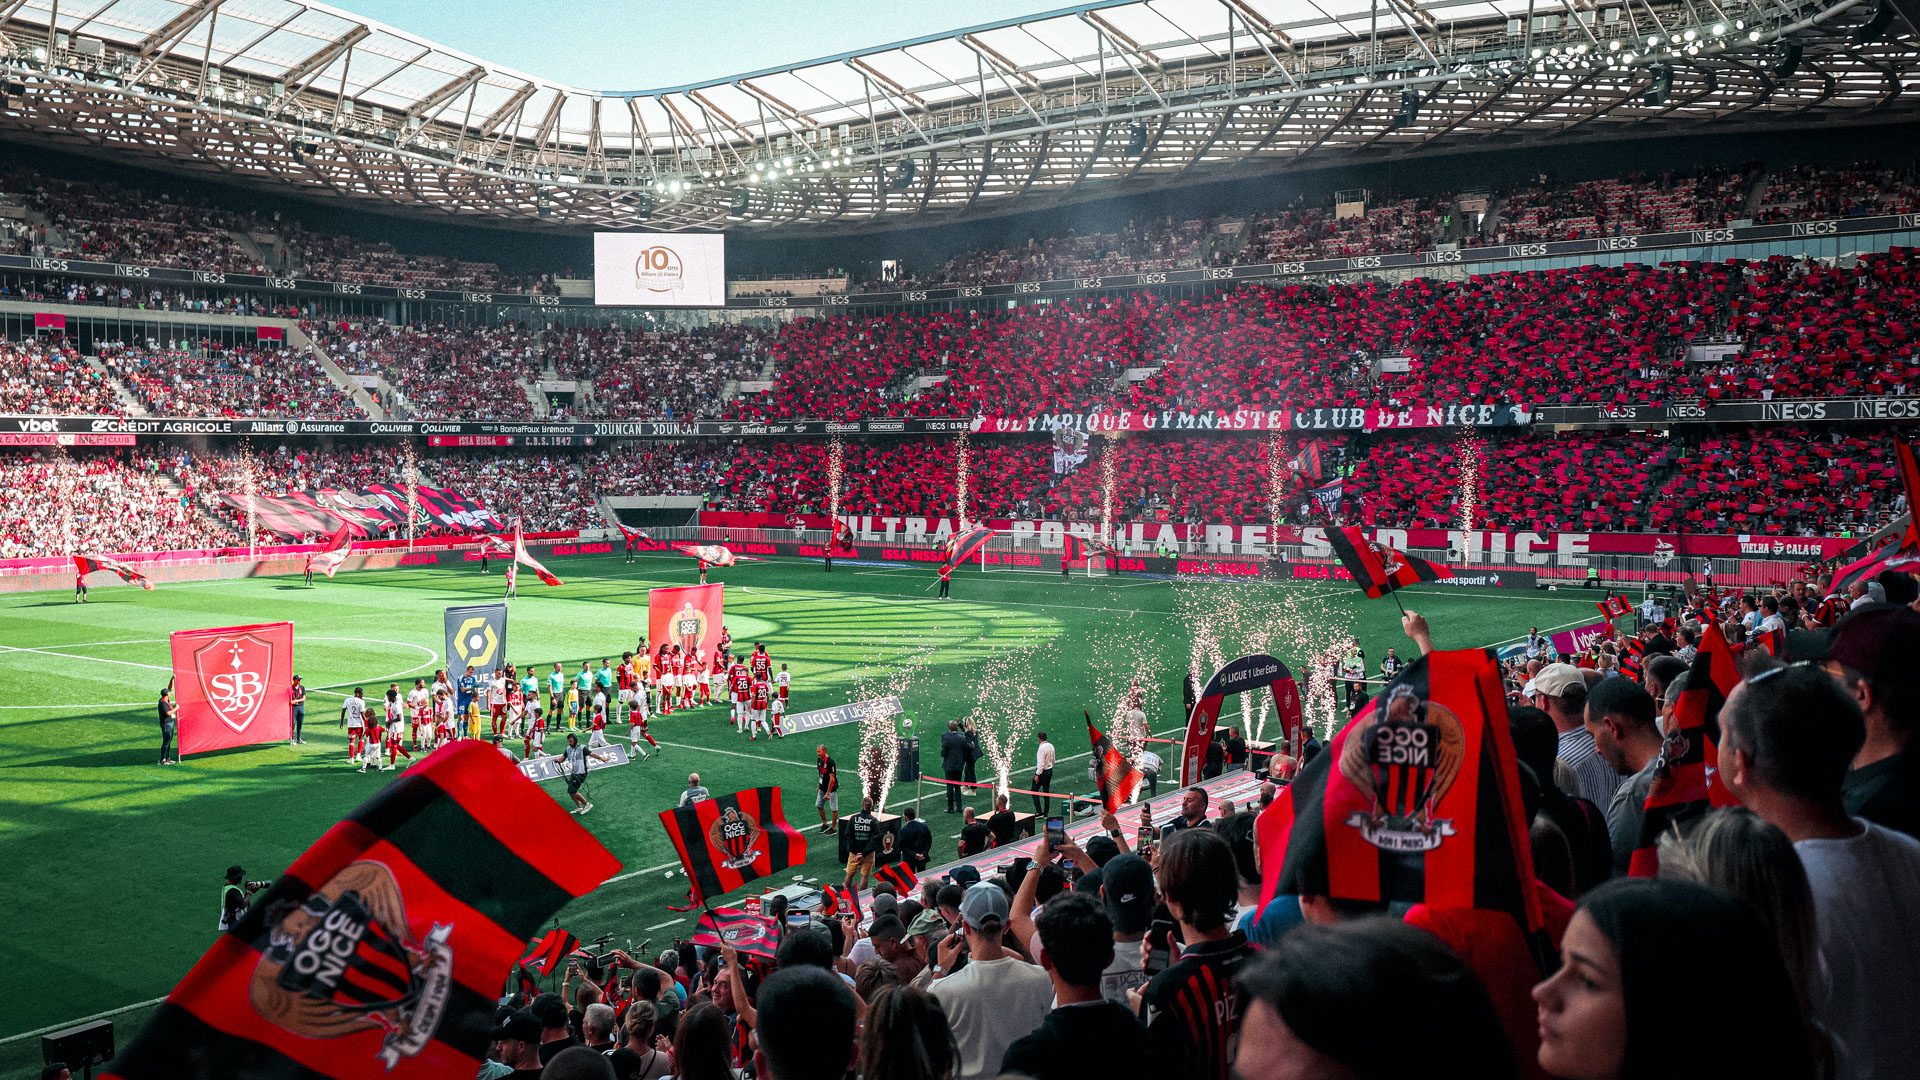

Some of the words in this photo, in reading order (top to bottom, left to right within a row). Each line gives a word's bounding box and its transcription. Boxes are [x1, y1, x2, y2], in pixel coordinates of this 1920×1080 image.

[1792, 221, 1838, 236] INEOS
[1692, 230, 1734, 244] INEOS
[1597, 238, 1637, 250] INEOS
[1509, 244, 1546, 257] INEOS
[640, 249, 669, 271] 10
[1348, 257, 1381, 269] INEOS
[1426, 251, 1461, 263] INEOS
[31, 258, 68, 271] INEOS
[1274, 263, 1305, 275] INEOS
[115, 265, 150, 278] INEOS
[1204, 268, 1234, 280] INEOS
[193, 273, 226, 284] INEOS
[266, 278, 296, 290] INEOS
[1075, 279, 1102, 289] INEOS
[1138, 274, 1166, 285] INEOS
[334, 284, 362, 295] INEOS
[958, 288, 983, 297] INEOS
[1015, 283, 1041, 293] INEOS
[397, 290, 426, 300] INEOS
[463, 294, 492, 304] INEOS
[823, 296, 850, 305] INEOS
[902, 292, 927, 302] INEOS
[530, 297, 560, 306] INEOS
[760, 298, 788, 307] INEOS
[1598, 407, 1636, 419] INEOS
[1666, 406, 1706, 418] INEOS
[1762, 403, 1826, 420] INEOS
[1854, 401, 1919, 419] INEOS
[996, 411, 1131, 432] OLYMPIQUE
[1143, 409, 1281, 431] GYMNASTE
[1295, 408, 1365, 429] CLUB
[1377, 406, 1412, 427] DE
[1426, 405, 1495, 426] NICE
[18, 418, 59, 432] vbet
[108, 420, 159, 433] CRÉDIT
[163, 422, 232, 434] AGRICOLE
[251, 422, 285, 433] Allianz
[300, 422, 345, 433] Assurance
[500, 425, 540, 433] Bonnaffoux
[740, 424, 767, 434] Tourtel
[926, 422, 946, 430] INEOS
[553, 545, 578, 556] ISSA
[580, 543, 612, 554] NISSA
[746, 543, 777, 555] NISSA
[799, 545, 823, 556] ISSA
[882, 548, 908, 560] ISSA
[1741, 542, 1769, 554] VIELHA
[1786, 544, 1809, 555] CALA
[972, 553, 1000, 565] ISSA
[1177, 560, 1211, 574] ISSA
[1214, 562, 1260, 576] NISSA
[1293, 565, 1331, 578] ISSA
[1459, 575, 1486, 586] sportif
[680, 620, 697, 629] OGC
[756, 661, 766, 670] 55
[1227, 670, 1247, 684] LIGUE
[1248, 669, 1252, 679] 1
[1253, 667, 1265, 678] Uber
[1265, 664, 1278, 674] Eats
[210, 671, 264, 701] SB
[737, 680, 748, 690] 26
[757, 688, 767, 698] 20
[221, 694, 255, 717] 29
[801, 709, 839, 728] LIGUE
[840, 707, 847, 720] 1
[854, 816, 872, 824] Uber
[723, 821, 744, 832] OGC
[854, 823, 871, 832] Eats
[725, 829, 746, 840] NICE
[293, 909, 349, 976] OGC
[314, 916, 365, 988] NICE
